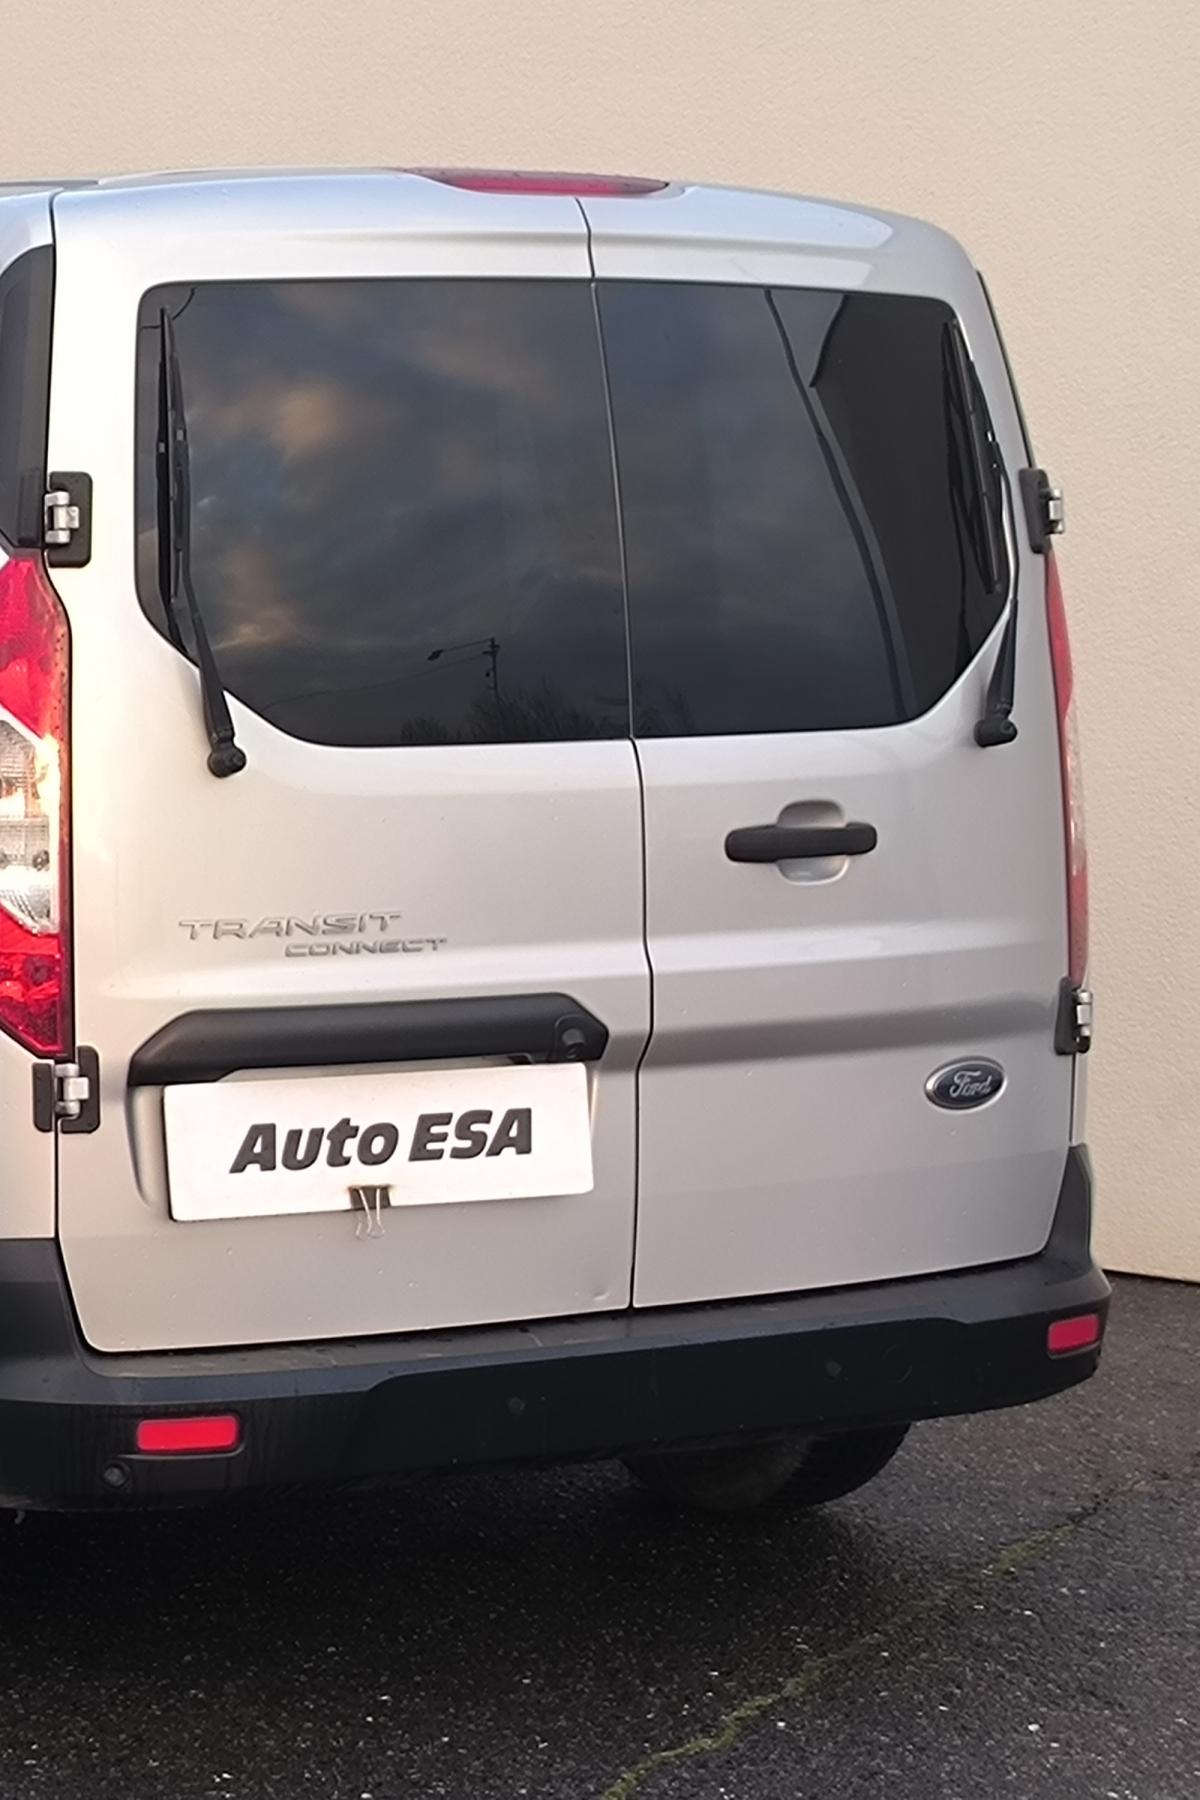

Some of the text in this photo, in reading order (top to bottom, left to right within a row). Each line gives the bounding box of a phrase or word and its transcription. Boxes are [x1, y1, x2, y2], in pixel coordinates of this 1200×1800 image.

[178, 911, 401, 940] TRANSIT
[284, 938, 448, 958] CONNECT
[949, 1070, 992, 1098] Ford
[229, 1107, 532, 1174] Auto ESA
